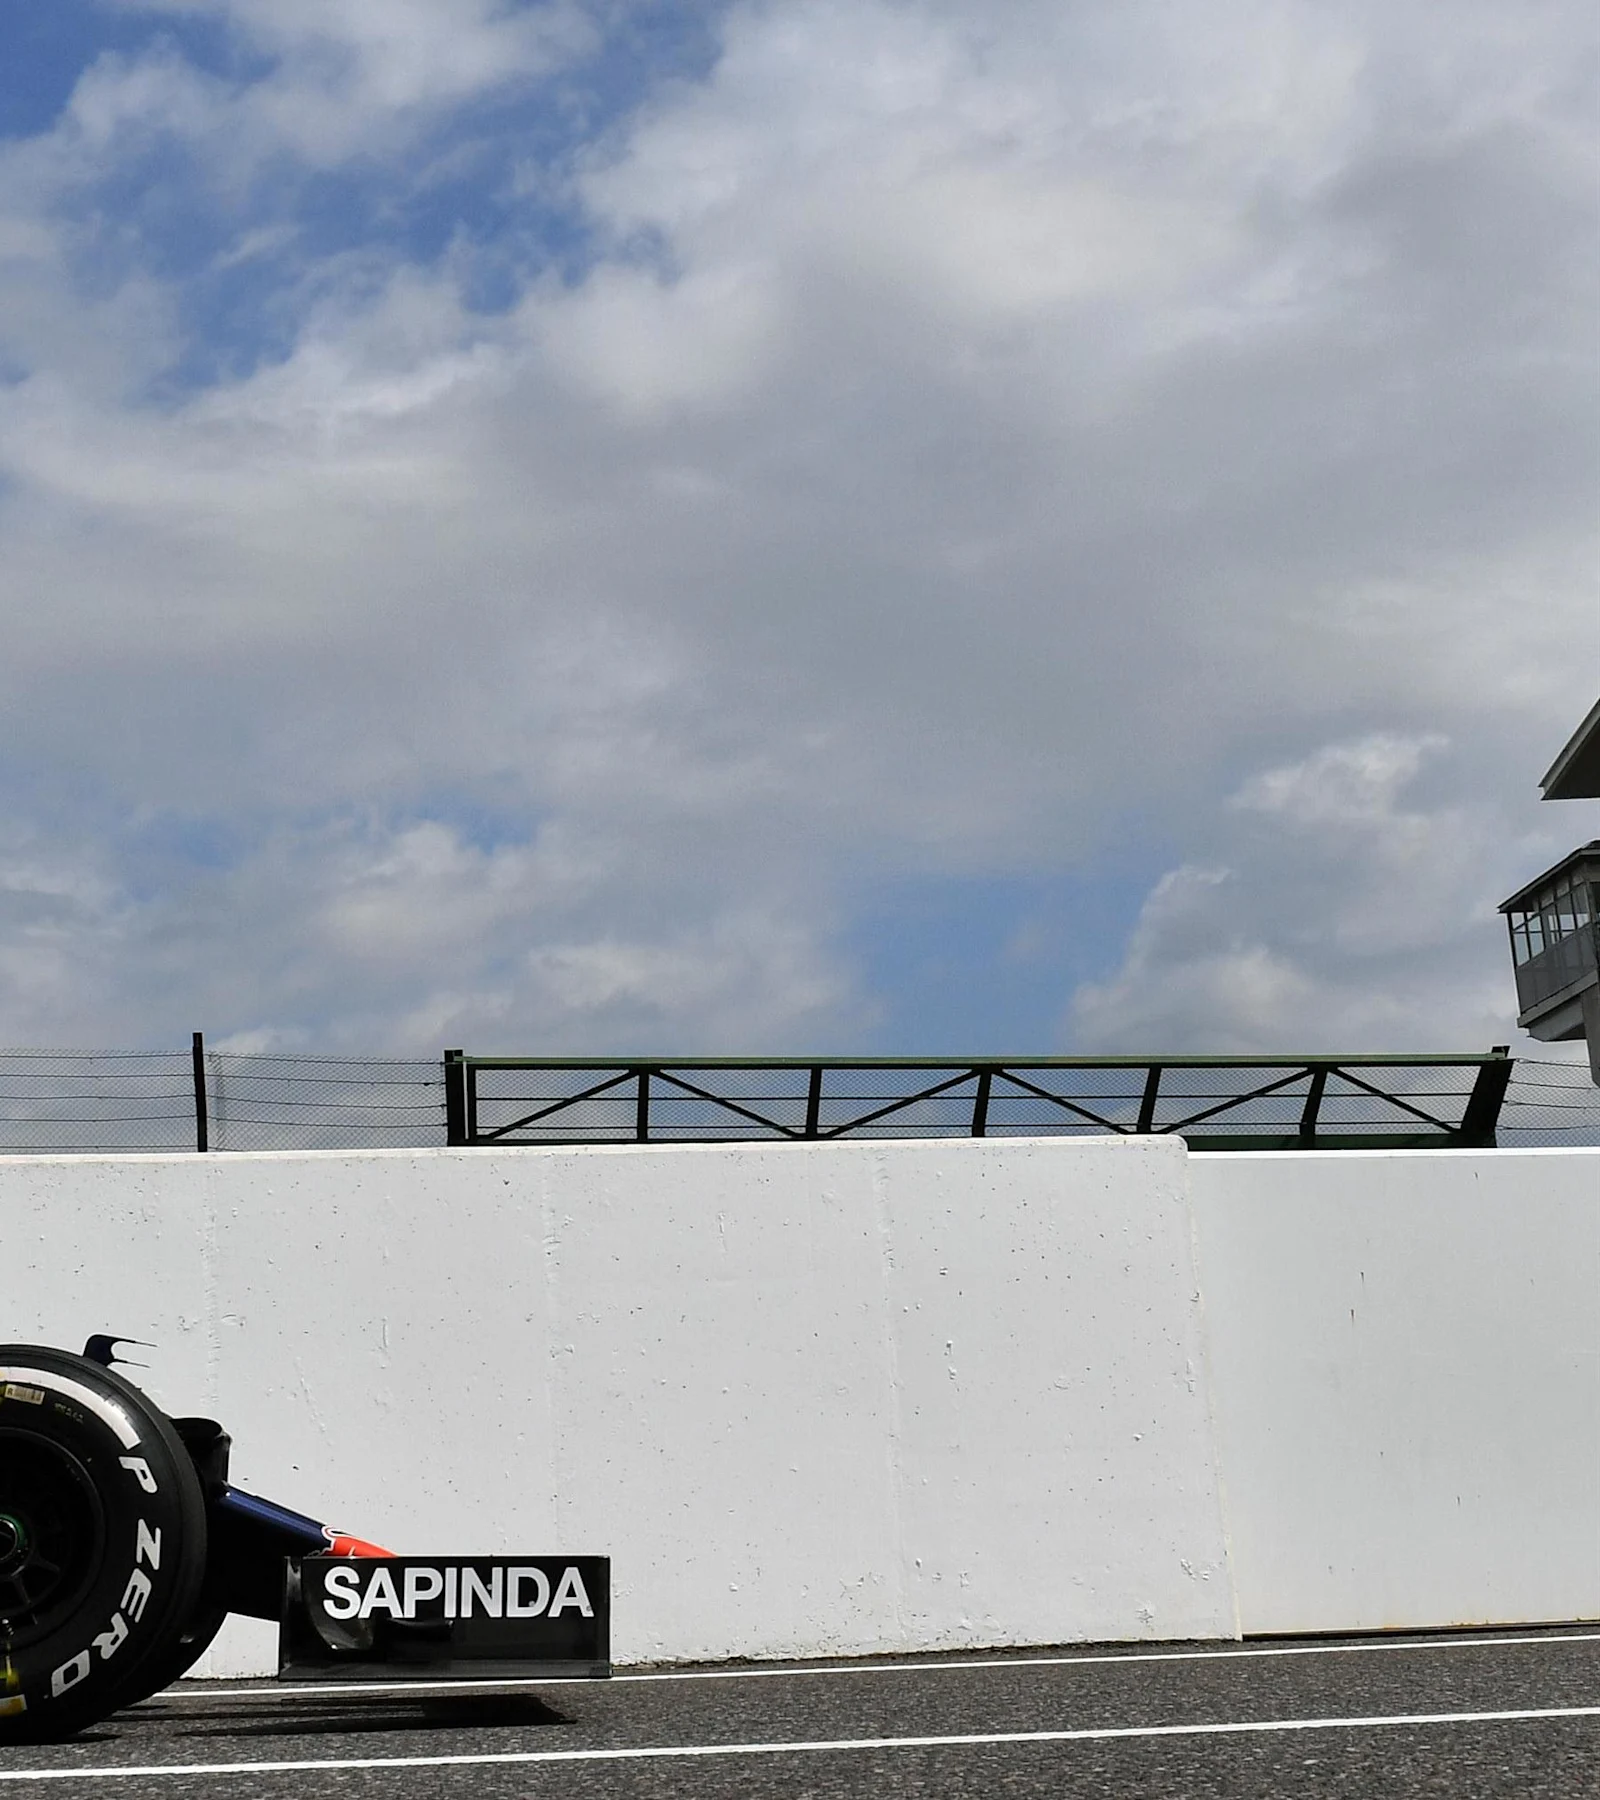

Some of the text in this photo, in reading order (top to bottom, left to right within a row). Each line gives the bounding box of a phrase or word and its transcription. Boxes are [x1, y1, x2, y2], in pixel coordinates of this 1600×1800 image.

[51, 1456, 162, 1698] P ZERO
[323, 1566, 595, 1620] SAPINDA
